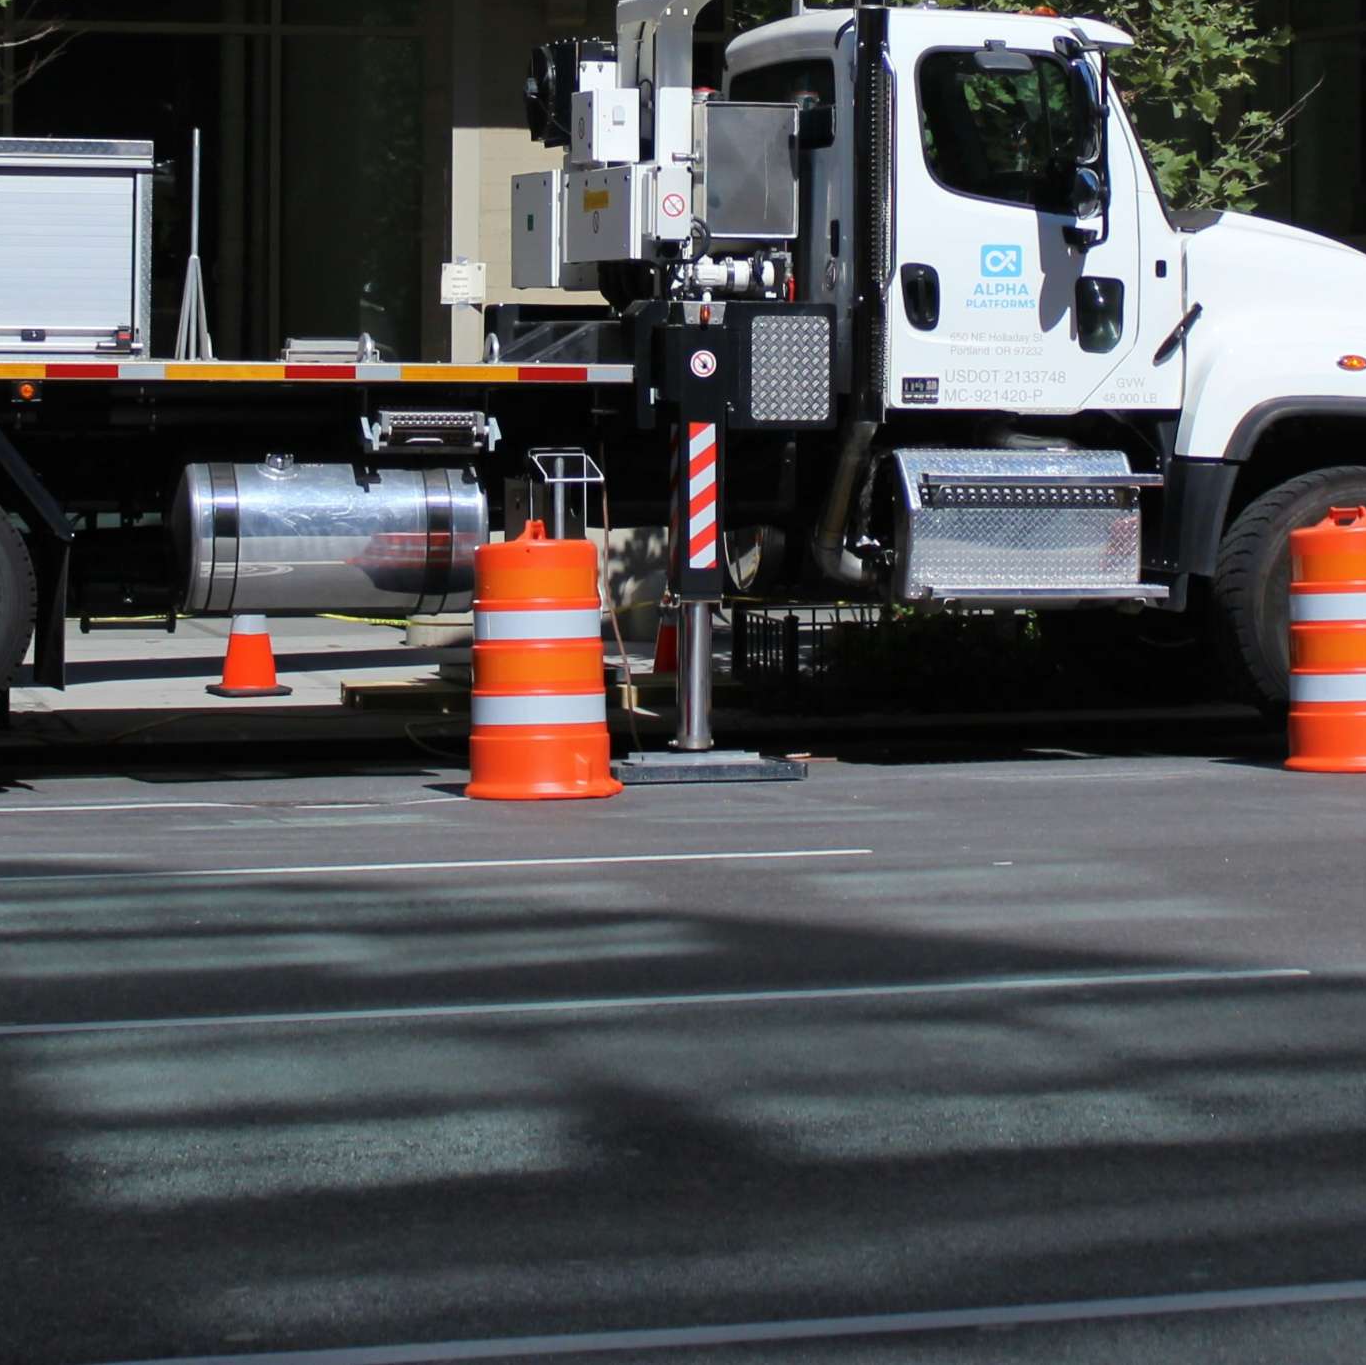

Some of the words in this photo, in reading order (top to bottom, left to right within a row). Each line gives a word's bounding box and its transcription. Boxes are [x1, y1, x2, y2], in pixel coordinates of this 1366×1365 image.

[973, 282, 1029, 296] ALPHA
[966, 299, 1036, 308] PLATFORMS
[949, 332, 969, 341] 650
[970, 332, 986, 341] NE
[1032, 332, 1043, 342] St
[995, 346, 1011, 356] OR
[1013, 346, 1044, 356] 97232
[944, 369, 1000, 384] USDOT
[1004, 370, 1067, 384] 2133748
[1116, 377, 1145, 388] GVW
[943, 388, 1044, 403] MC-921420-P
[1143, 393, 1158, 404] LB
